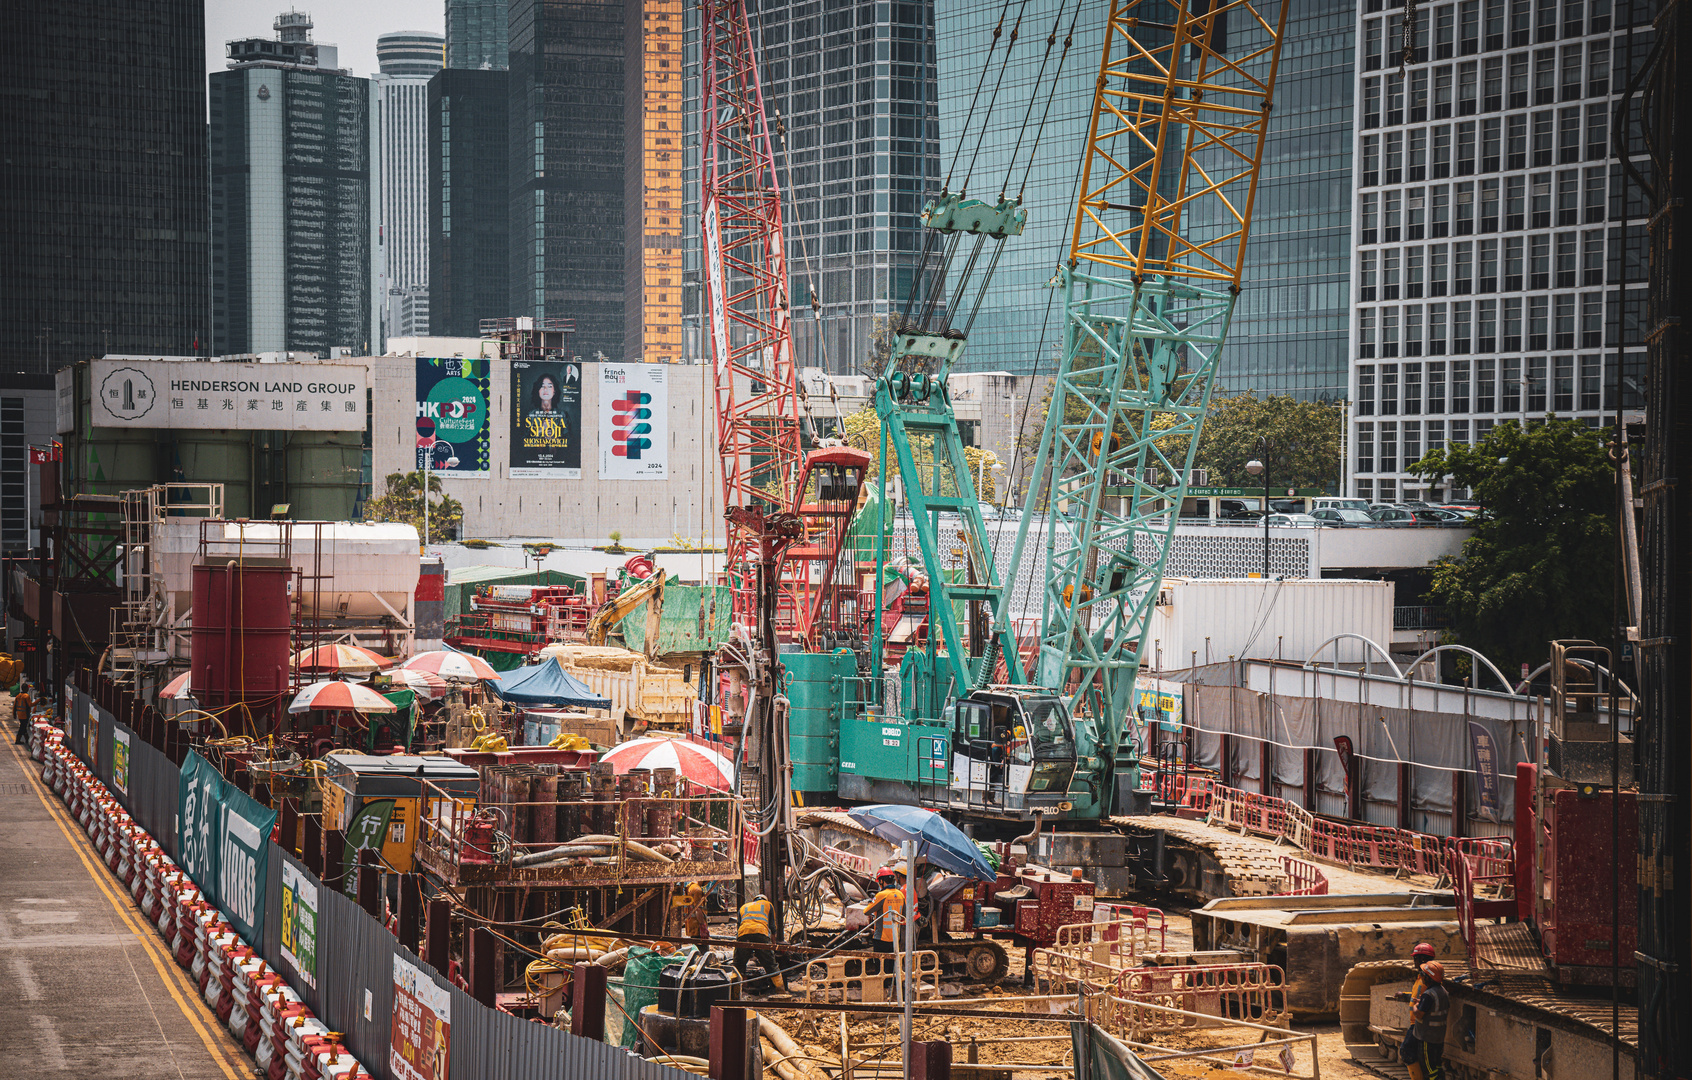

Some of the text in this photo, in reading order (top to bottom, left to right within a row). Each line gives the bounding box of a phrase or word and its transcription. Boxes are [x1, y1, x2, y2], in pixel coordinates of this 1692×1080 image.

[604, 374, 619, 384] may
[171, 380, 356, 394] HENDERSON LAND GROUP
[109, 389, 147, 399] 恒 基
[462, 396, 477, 404] 2024
[171, 397, 356, 412] 恒基兆業地產集團
[525, 416, 567, 429] SAYAKA
[530, 426, 562, 439] SHOJI
[1623, 644, 1631, 655] P
